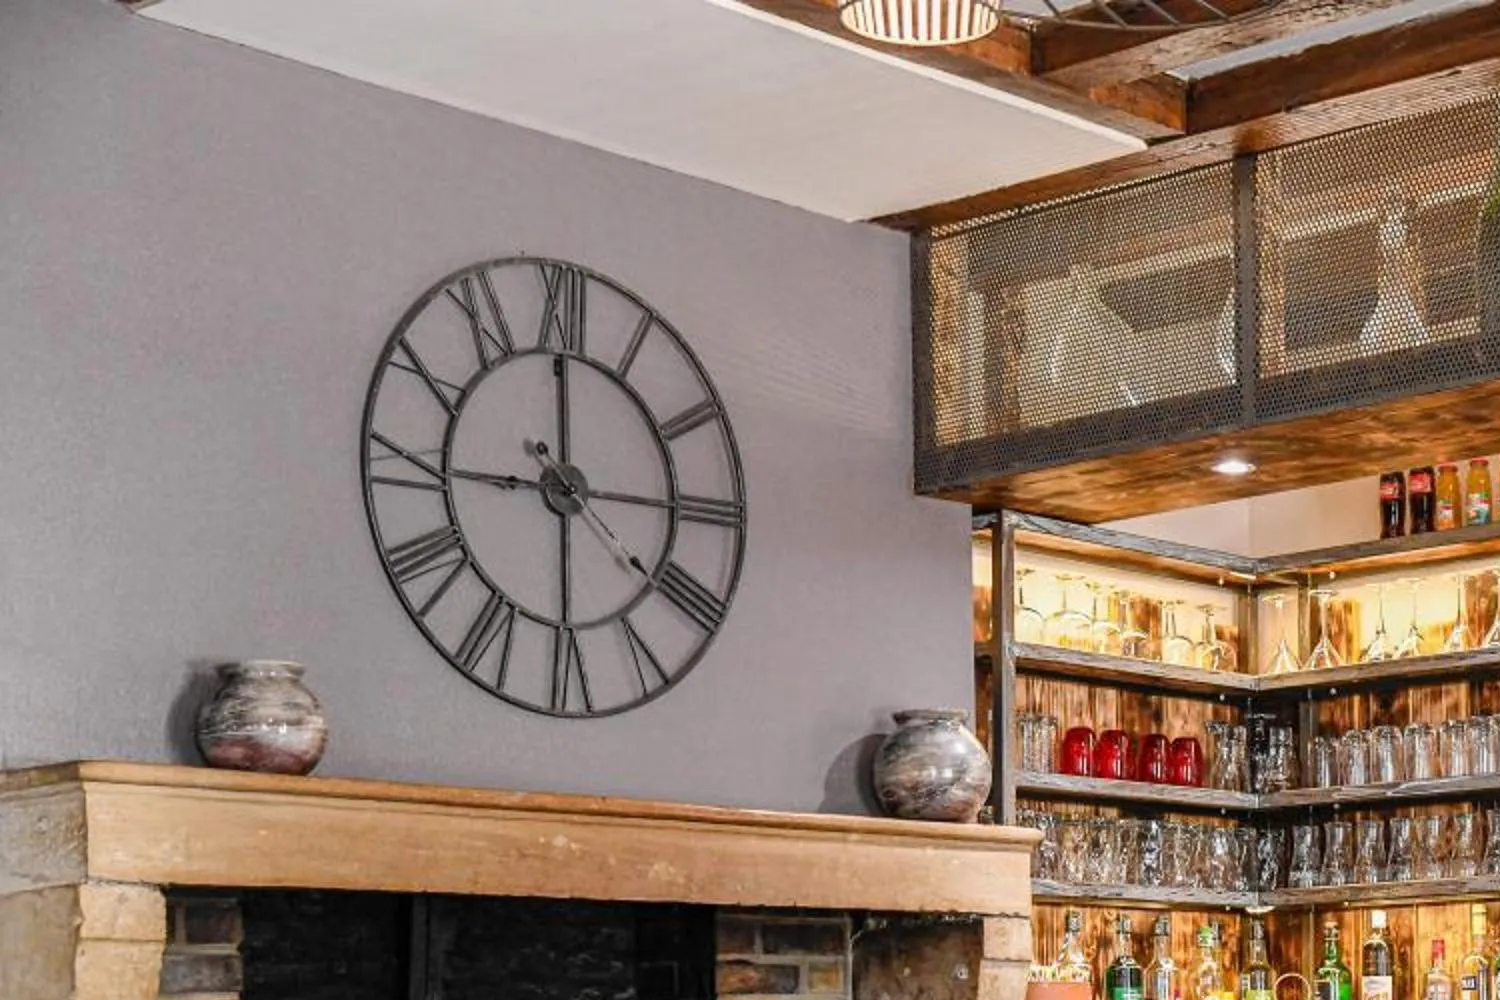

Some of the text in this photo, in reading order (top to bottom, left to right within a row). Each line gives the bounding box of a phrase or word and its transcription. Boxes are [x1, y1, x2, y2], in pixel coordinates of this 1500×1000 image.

[444, 271, 515, 370] XI
[537, 261, 587, 356] XII
[616, 311, 656, 380] I
[386, 335, 467, 417] X
[367, 430, 448, 492] IX
[658, 398, 722, 443] II
[677, 493, 744, 530] III
[384, 526, 468, 620] VIII
[453, 591, 516, 690] VII
[551, 627, 593, 714] VI
[620, 616, 671, 699] V
